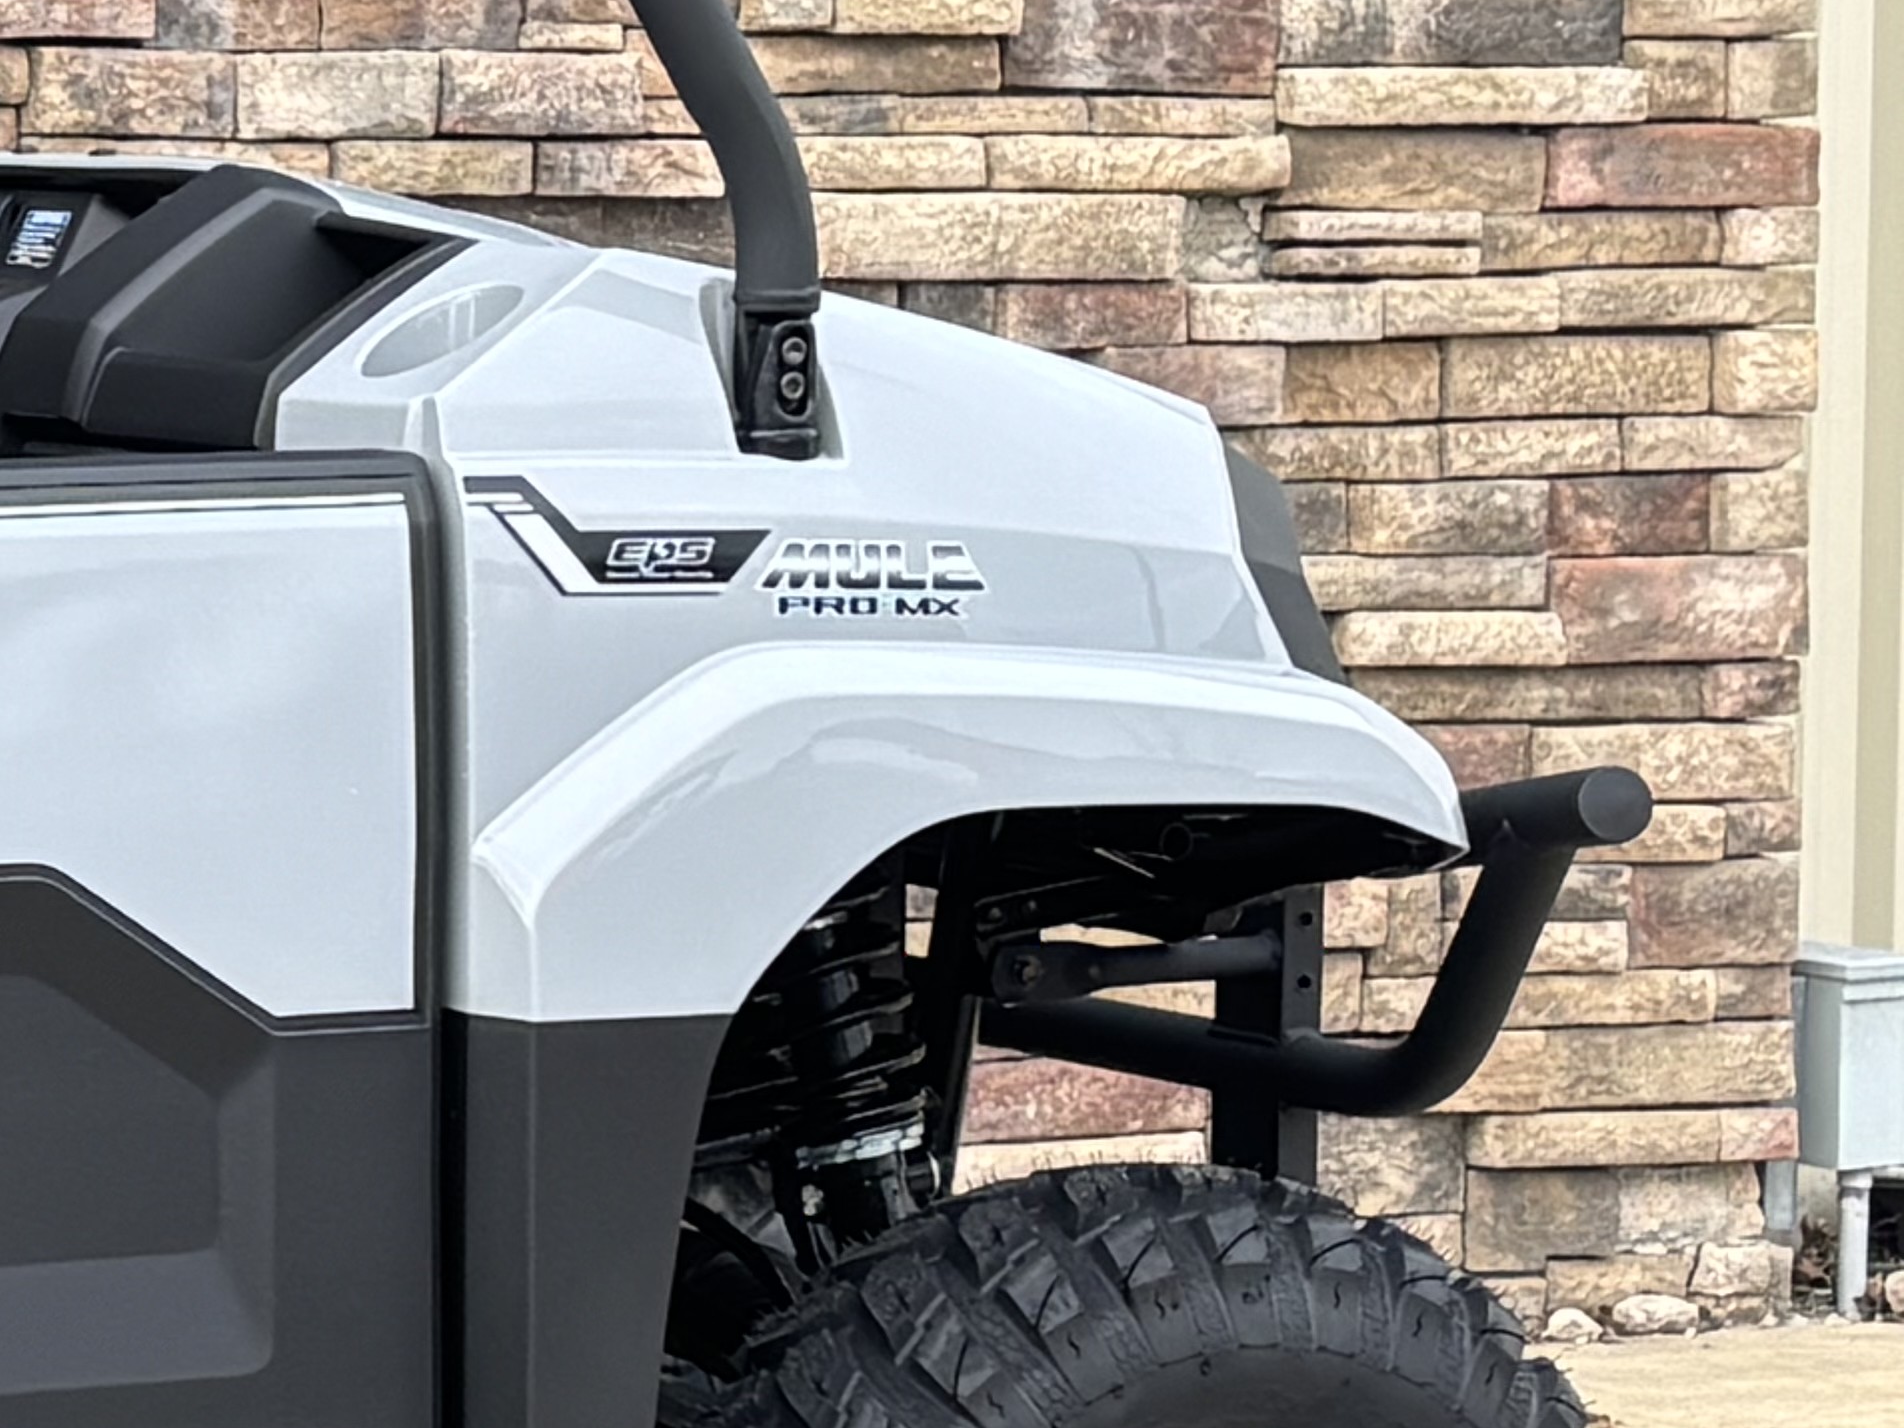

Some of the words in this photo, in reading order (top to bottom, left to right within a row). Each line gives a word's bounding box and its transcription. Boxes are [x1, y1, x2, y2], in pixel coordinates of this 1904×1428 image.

[756, 539, 989, 591] MULE
[778, 596, 878, 616] PRO
[894, 596, 962, 617] MX
